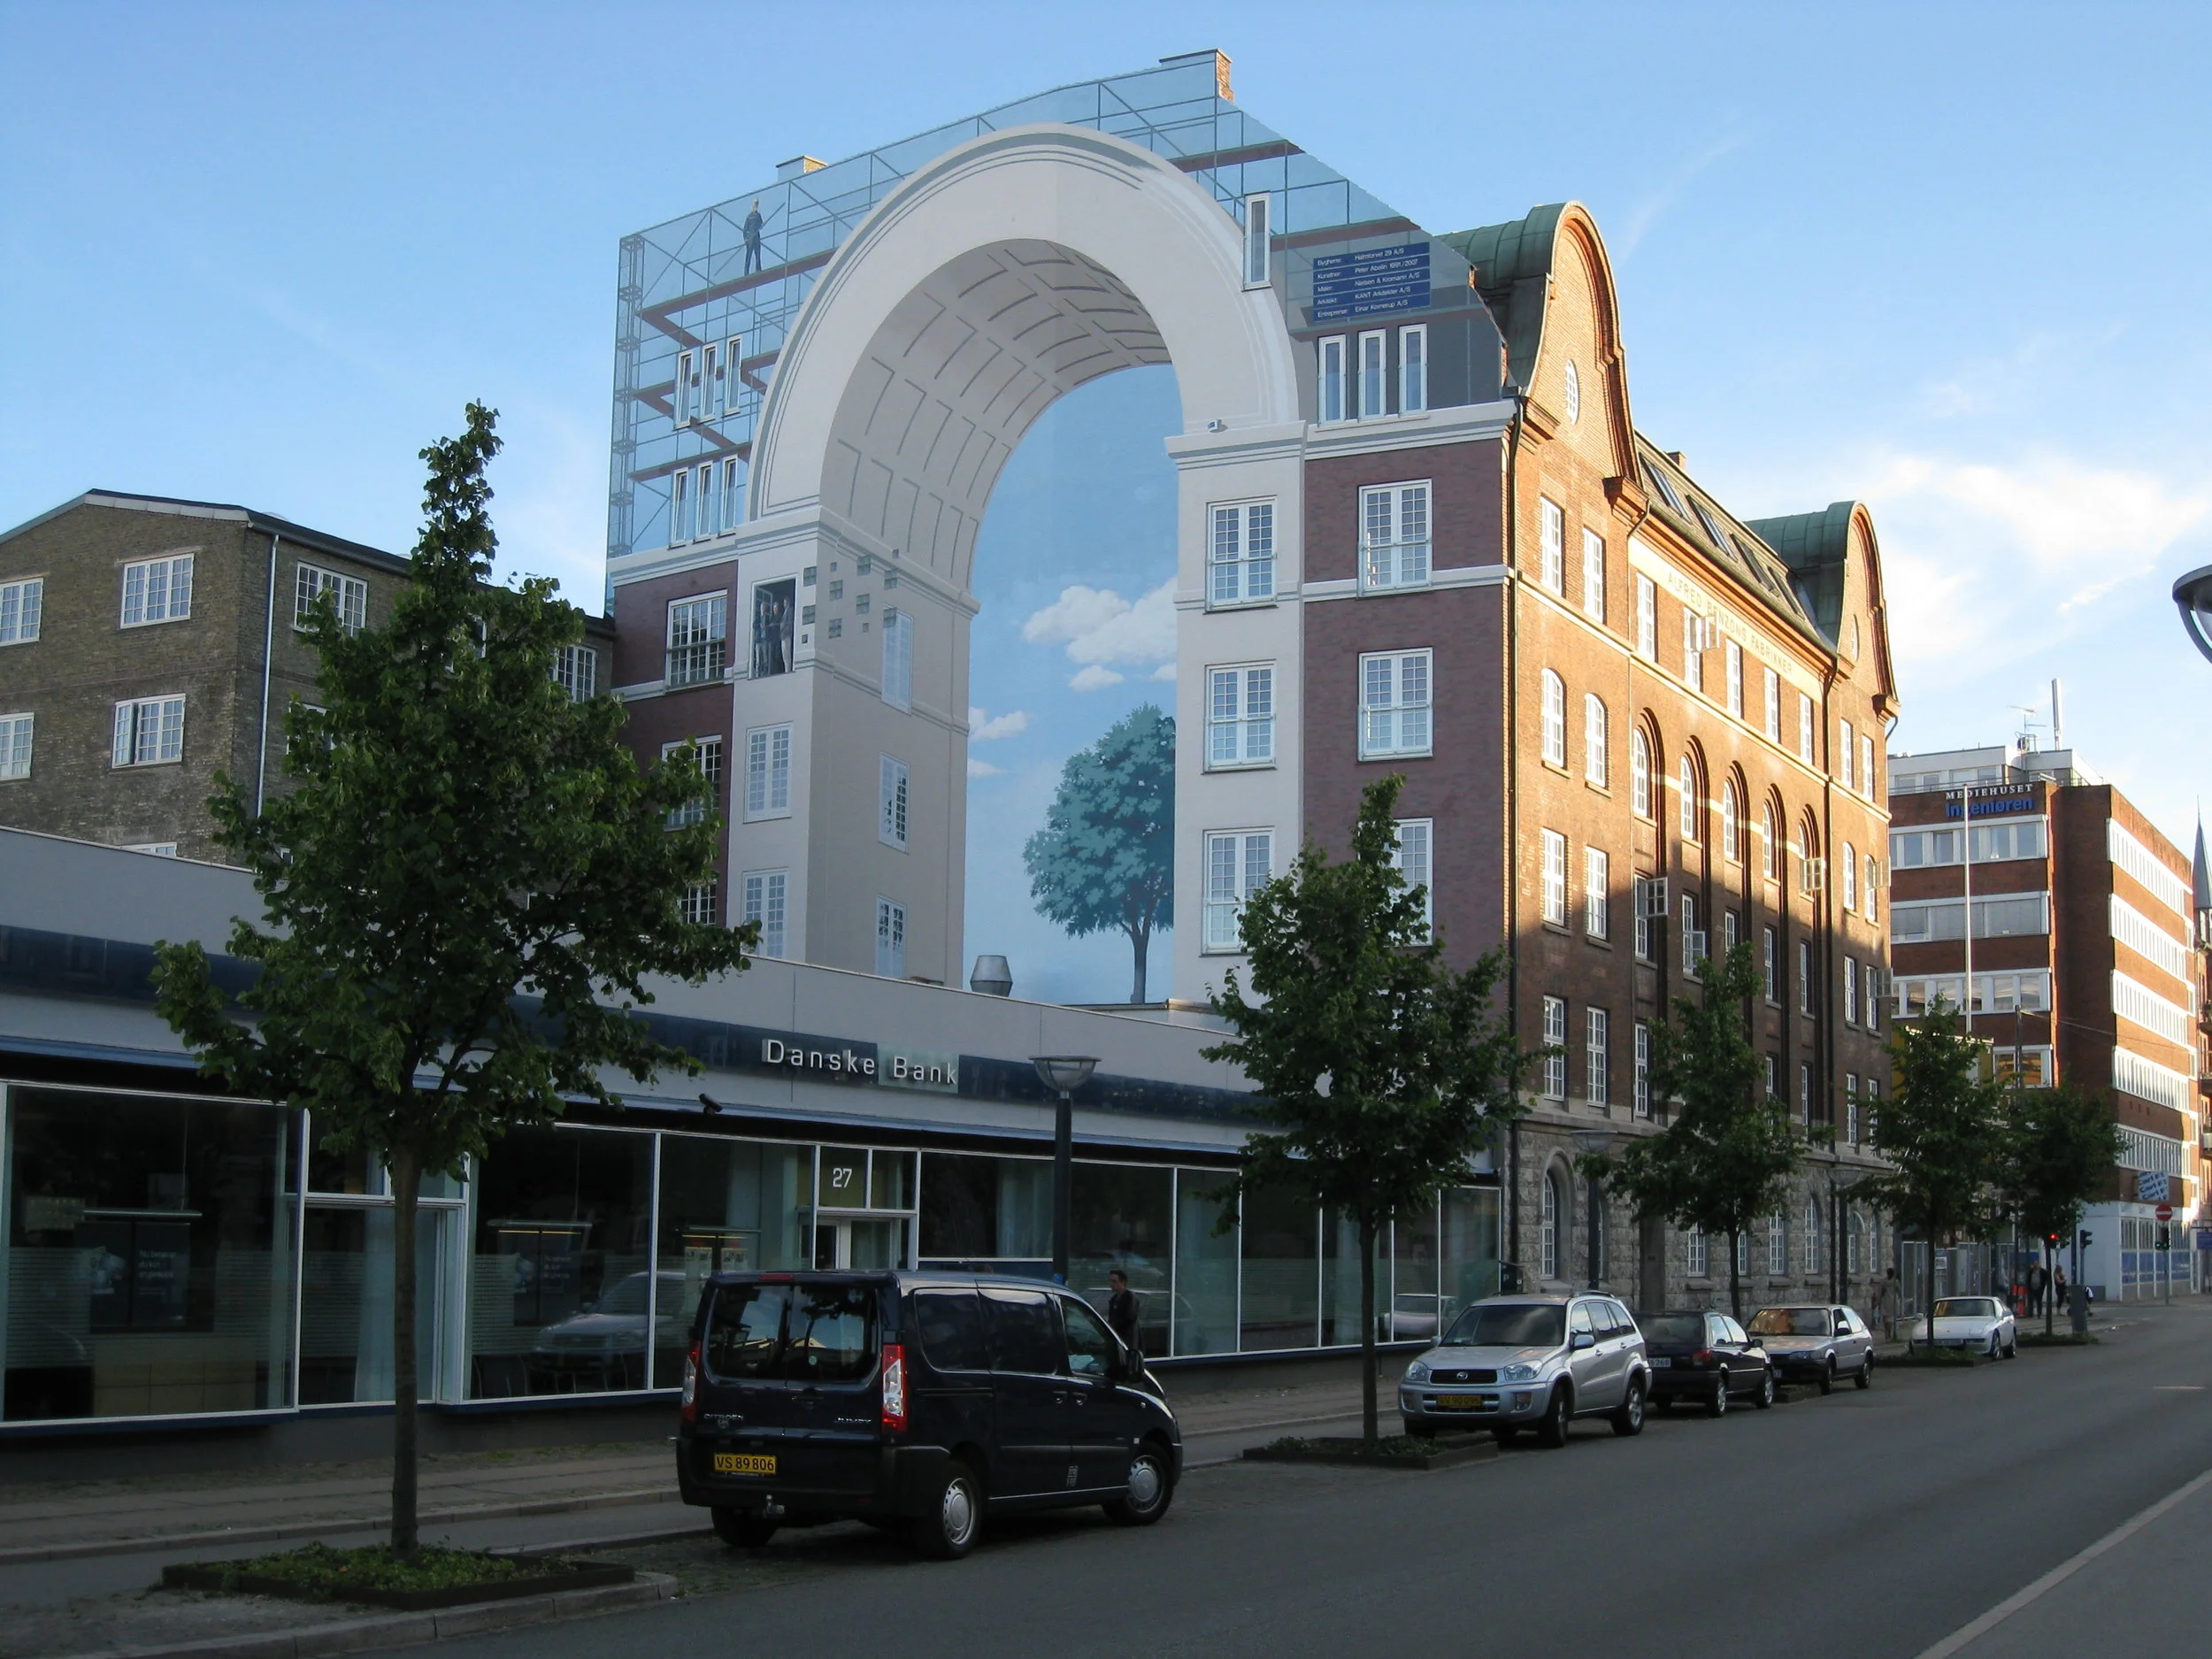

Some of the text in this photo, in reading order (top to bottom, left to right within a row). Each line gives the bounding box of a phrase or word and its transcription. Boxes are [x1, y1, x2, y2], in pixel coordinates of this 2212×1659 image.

[1382, 274, 1408, 283] Kromann
[1355, 291, 1371, 300] KANT
[1946, 784, 2033, 800] MEDIEHUSET
[764, 1039, 957, 1085] Danske Bank
[833, 1167, 853, 1188] 27
[716, 1455, 774, 1471] VS 89 806
